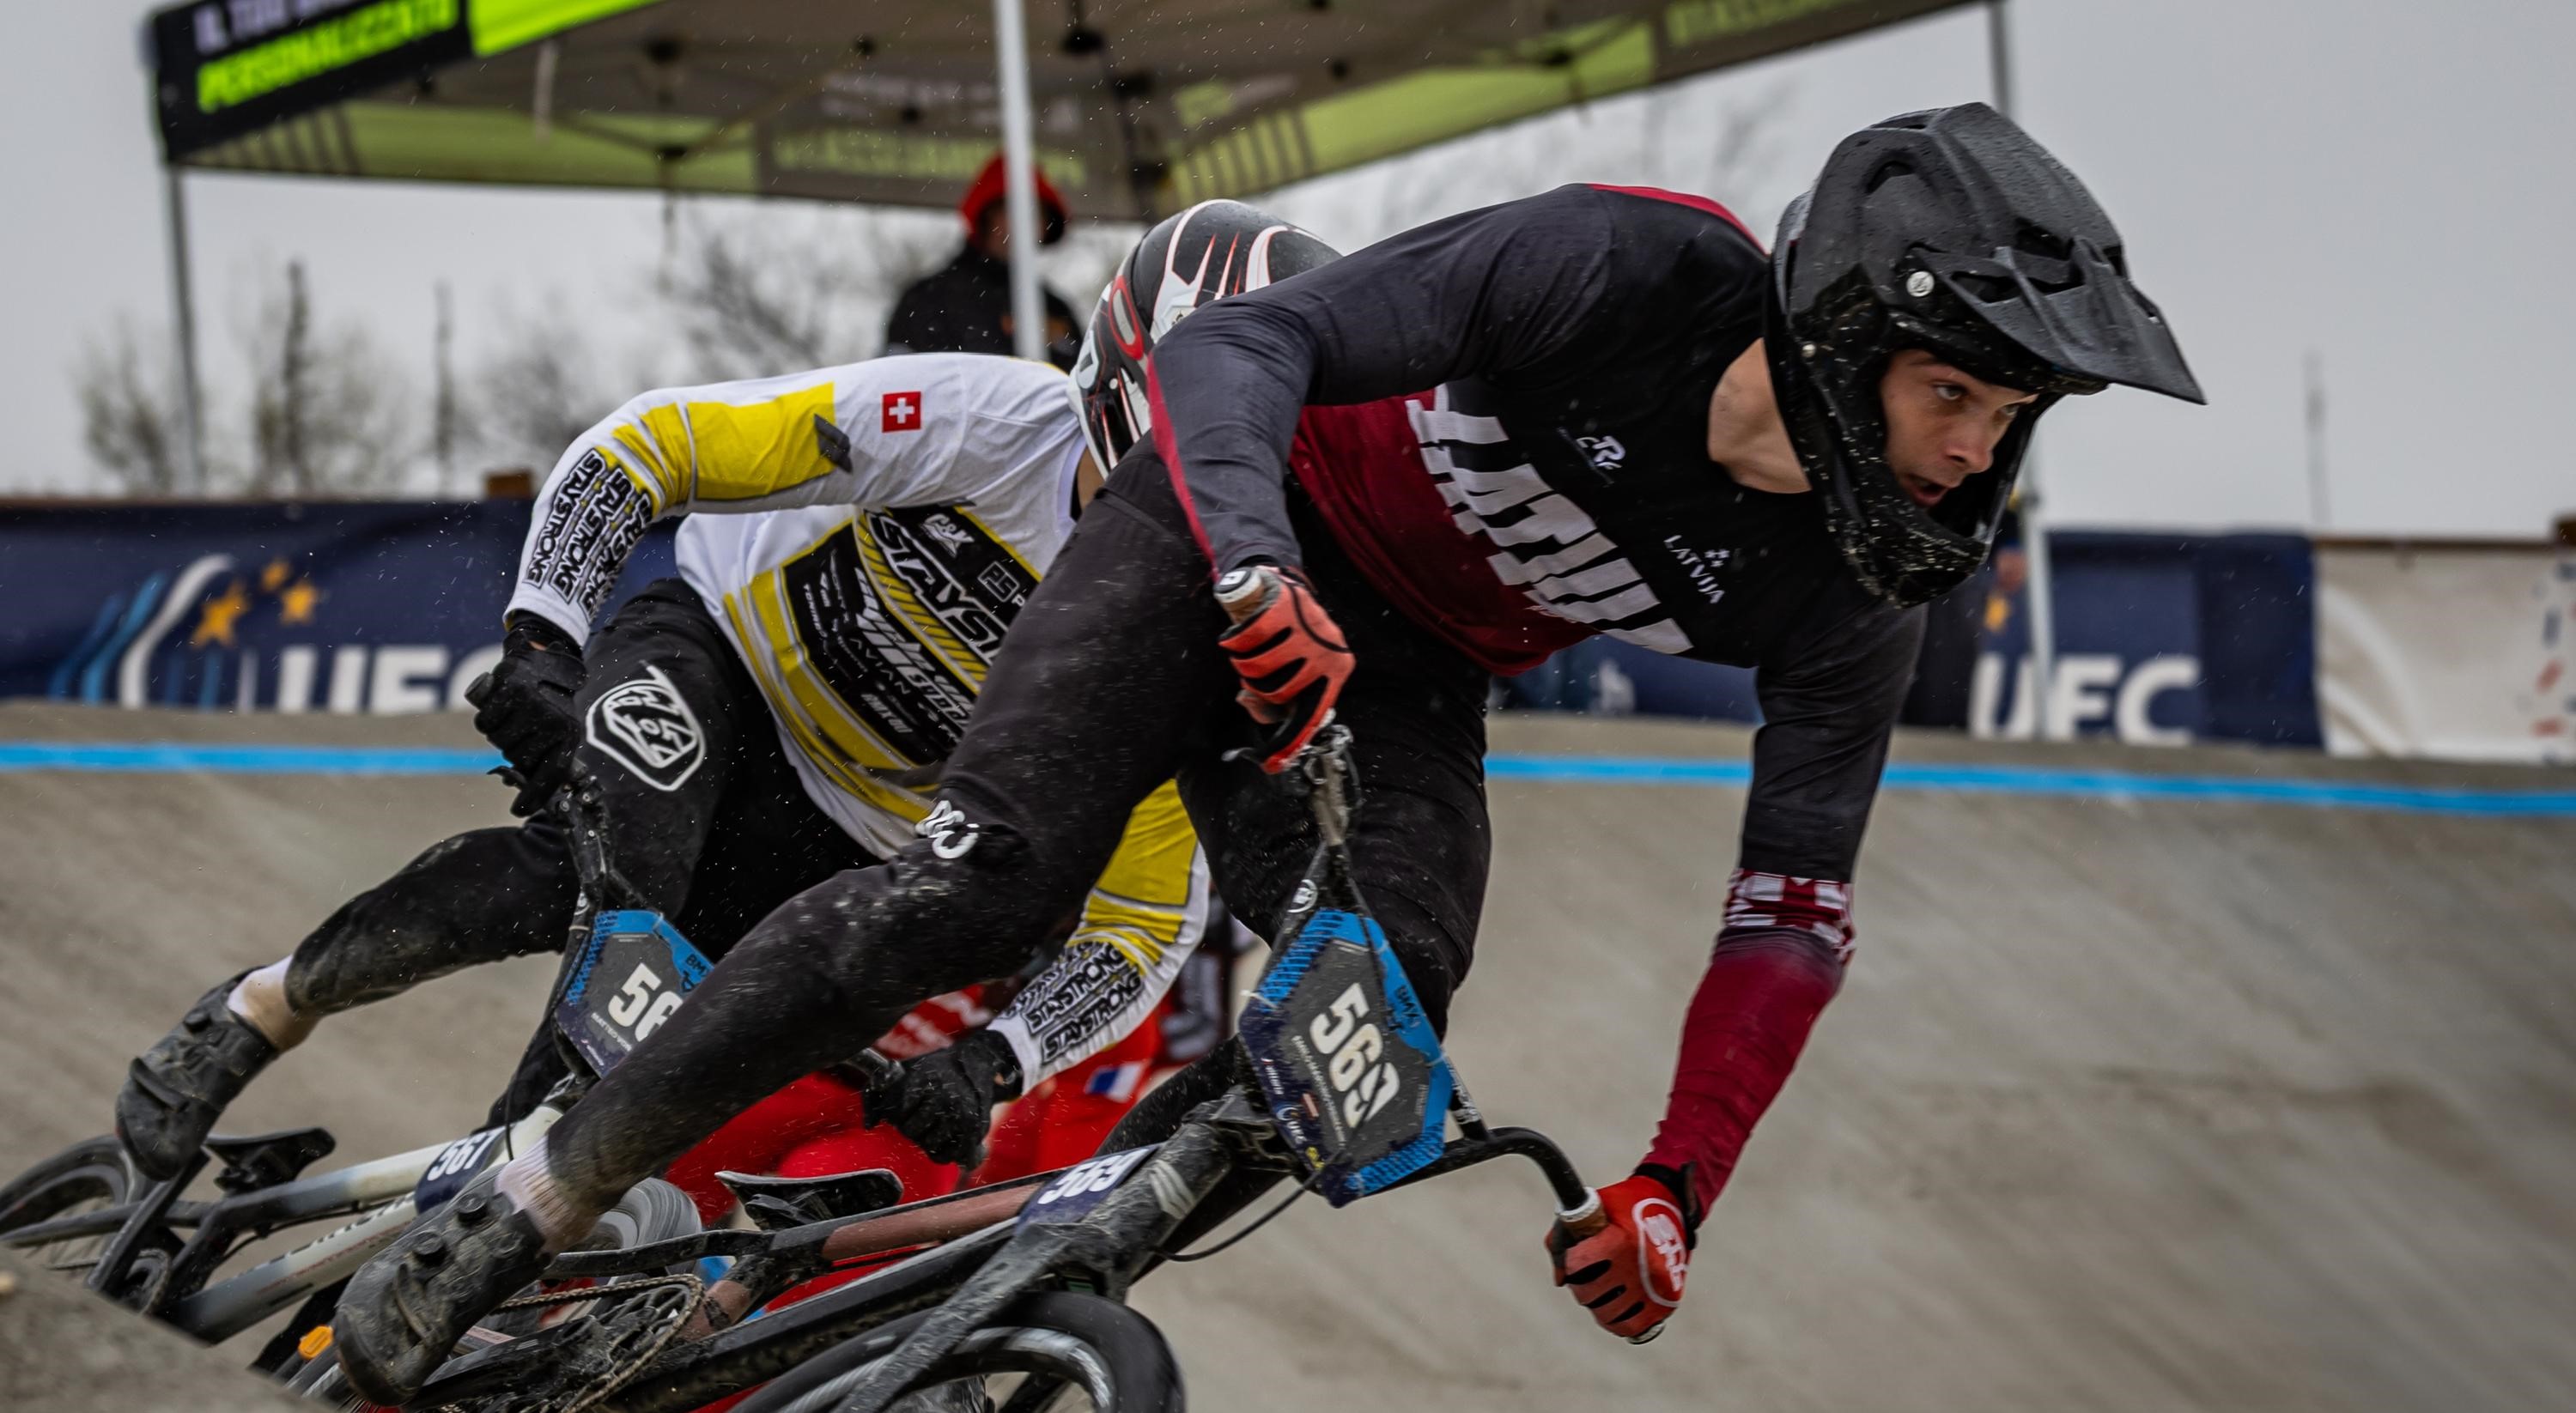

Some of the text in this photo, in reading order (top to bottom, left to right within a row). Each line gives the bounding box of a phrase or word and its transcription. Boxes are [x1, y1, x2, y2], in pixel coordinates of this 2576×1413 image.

[526, 452, 604, 585] STAYSTRONG
[556, 471, 634, 599] STAYSTRONG
[869, 515, 1008, 661] STAYST
[1664, 535, 1725, 603] LATVIJA
[608, 962, 683, 1043] 56
[1042, 973, 1143, 1058] STAYSTRONG
[1309, 982, 1400, 1128] 569
[428, 1129, 498, 1181] 567
[1037, 1148, 1149, 1205] 569
